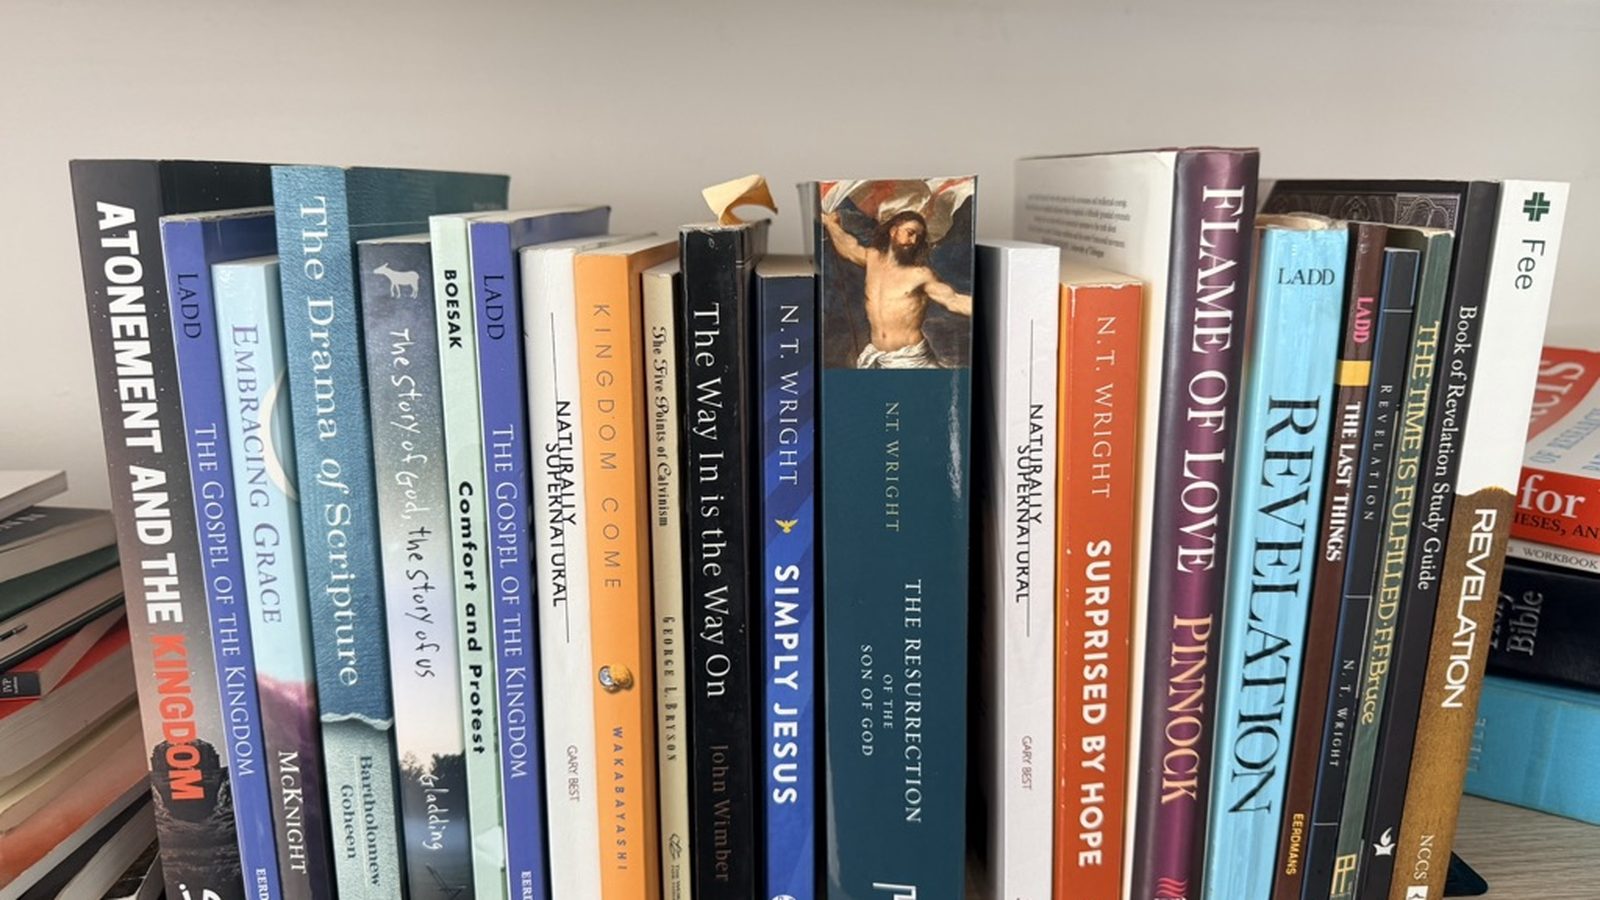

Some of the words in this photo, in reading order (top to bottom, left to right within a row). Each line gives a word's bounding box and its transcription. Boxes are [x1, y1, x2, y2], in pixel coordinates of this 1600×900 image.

[300, 195, 328, 281] The
[1515, 239, 1545, 290] Fee
[1192, 185, 1245, 353] FLAME
[1278, 268, 1335, 286] LADD
[97, 201, 163, 453] ATONEMENT
[178, 273, 202, 339] LADD
[444, 269, 463, 350] BOESAK
[484, 274, 505, 340] LADD
[693, 303, 720, 368] The
[780, 305, 799, 332] N.
[1096, 316, 1116, 344] N.
[1353, 296, 1374, 342] LADD
[1453, 305, 1478, 354] Book
[307, 297, 339, 442] Drama
[390, 328, 410, 368] The
[653, 326, 667, 354] The
[780, 339, 799, 359] T.
[1095, 350, 1115, 371] T.
[1412, 321, 1440, 380] THE
[593, 304, 617, 469] KINGDOM
[654, 359, 668, 392] Five
[1451, 359, 1468, 382] of
[655, 396, 669, 442] Points
[693, 377, 723, 440] Way
[779, 372, 798, 486] WRIGHT
[1188, 370, 1228, 434] OF
[1341, 401, 1362, 439] THE
[1401, 383, 1430, 452] TIME
[1435, 384, 1466, 476] Revelation
[195, 422, 218, 472] THE
[402, 440, 427, 466] of
[492, 424, 513, 472] THE
[555, 401, 576, 526] NATURALLY
[657, 446, 668, 457] of
[699, 452, 724, 483] In
[1029, 403, 1043, 525] NATURALLY
[1092, 383, 1114, 498] WRIGHT
[1336, 444, 1356, 485] LAST
[1363, 385, 1393, 521] REVELATION
[1398, 456, 1418, 480] IS
[231, 324, 270, 509] EMBRACING
[253, 523, 282, 624] GRACE
[317, 458, 349, 494] of
[657, 462, 671, 526] Calvinism
[885, 442, 900, 532] WRIGHT
[1518, 474, 1586, 518] for
[129, 465, 173, 546] AND
[202, 480, 230, 567] GOSPEL
[495, 481, 518, 568] GOSPEL
[545, 443, 567, 607] SUPERNATURAL
[700, 496, 725, 518] is
[1016, 445, 1030, 603] SUPERNATURAL
[1177, 448, 1226, 573] LOVE
[1326, 492, 1350, 561] THINGS
[1422, 482, 1450, 533] Study
[408, 525, 432, 562] the
[459, 481, 479, 590] Comfort
[600, 498, 621, 588] COME
[701, 529, 727, 576] the
[1378, 485, 1415, 620] FULFILLED
[1418, 538, 1441, 590] Guide
[1522, 547, 1599, 570] WORKBOOK
[141, 552, 184, 624] THE
[213, 577, 234, 604] OF
[325, 504, 358, 687] Scripture
[500, 576, 521, 605] OF
[700, 586, 729, 645] Way
[905, 579, 921, 629] THE
[1228, 395, 1320, 814] REVELATION
[1441, 507, 1497, 708] REVELATION
[218, 611, 241, 657] THE
[416, 630, 440, 653] of
[464, 603, 483, 652] and
[502, 612, 523, 657] THE
[662, 616, 675, 677] GEORGE
[773, 564, 799, 690] SIMPLY
[1082, 540, 1112, 724] SURPRISED
[1506, 591, 1543, 656] Bible
[416, 659, 435, 679] us
[706, 653, 731, 698] On
[860, 644, 873, 680] SON
[883, 675, 893, 693] OF
[152, 634, 206, 800] KINGDOM
[225, 666, 254, 777] KINGDOM
[468, 665, 486, 754] Protest
[505, 666, 529, 778] KINGDOM
[861, 688, 873, 709] OF
[883, 700, 893, 729] THE
[1161, 615, 1212, 804] PINNOCK
[566, 745, 579, 777] GARY
[664, 703, 678, 761] BRYSON
[772, 703, 798, 804] JESUS
[861, 718, 873, 757] GOD
[904, 639, 922, 824] RESURRECTION
[1021, 736, 1032, 765] GARY
[1081, 736, 1105, 771] BY
[1329, 708, 1348, 767] WRIGHT
[568, 779, 580, 803] BEST
[710, 745, 729, 792] John
[1021, 766, 1033, 791] BEST
[340, 784, 357, 859] Goheen
[360, 755, 381, 888] Bartholomew
[612, 727, 627, 871] WAKABAYASHI
[1078, 783, 1104, 867] HOPE
[712, 798, 731, 882] Wimber
[1286, 813, 1305, 876] EERDMANS
[1413, 834, 1435, 880] NCCS
